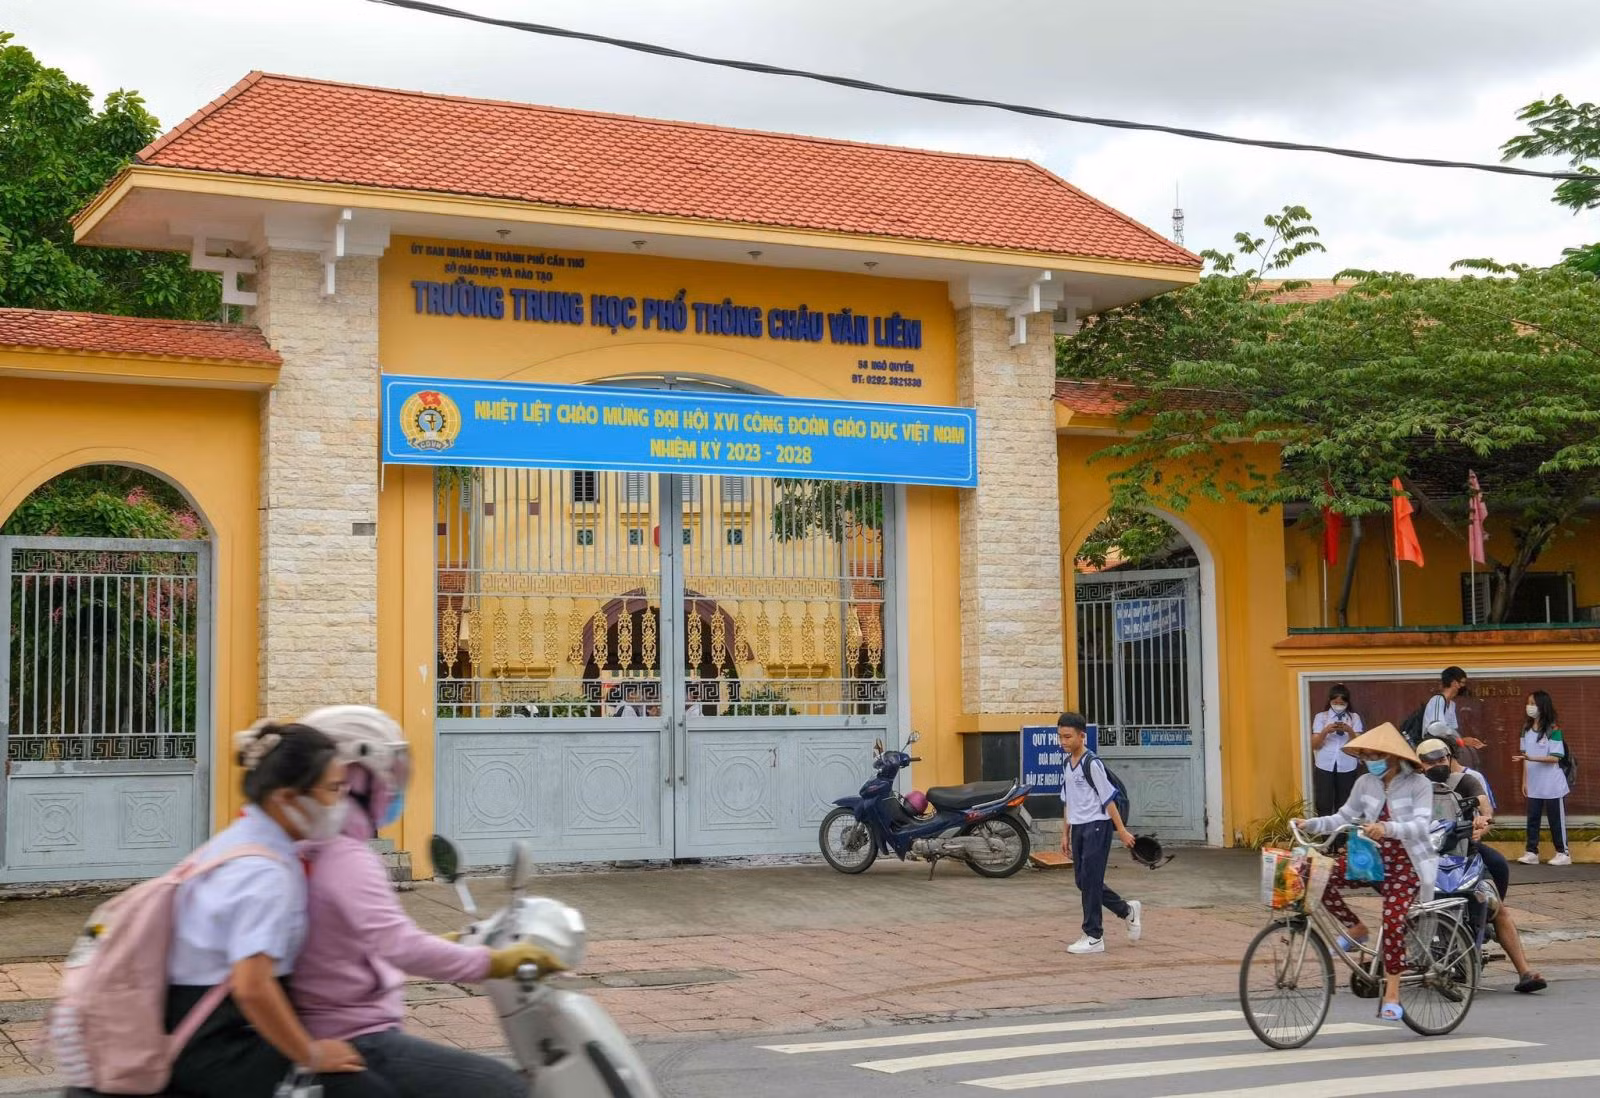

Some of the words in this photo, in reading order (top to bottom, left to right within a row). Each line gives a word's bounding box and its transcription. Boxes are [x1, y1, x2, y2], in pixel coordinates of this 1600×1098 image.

[501, 267, 512, 278] VÀ
[536, 271, 553, 283] TẠO
[411, 276, 504, 319] TRƯỜNG
[510, 288, 584, 325] TRUNG
[591, 294, 637, 335] HỌC
[691, 298, 763, 337] THÔNG
[767, 304, 824, 342] CHÂU
[828, 307, 869, 346] VĂN
[874, 311, 922, 349] LIÊM
[475, 398, 518, 425] NHIỆT
[522, 400, 552, 427] LIỆT
[557, 402, 599, 425] CHÀO
[654, 409, 679, 433] ĐẠI
[683, 408, 709, 433] HỘI
[713, 412, 738, 431] XVI
[743, 411, 784, 434] CÔNG
[788, 413, 829, 436] ĐOÀN
[833, 416, 867, 438] GIÁO
[870, 421, 898, 444] DỤC
[902, 420, 931, 446] VIỆT
[934, 425, 965, 444] NAM
[650, 436, 697, 462] NHIỆM
[701, 438, 721, 460] KỲ
[727, 442, 762, 462] 2023
[776, 444, 813, 465] 2028
